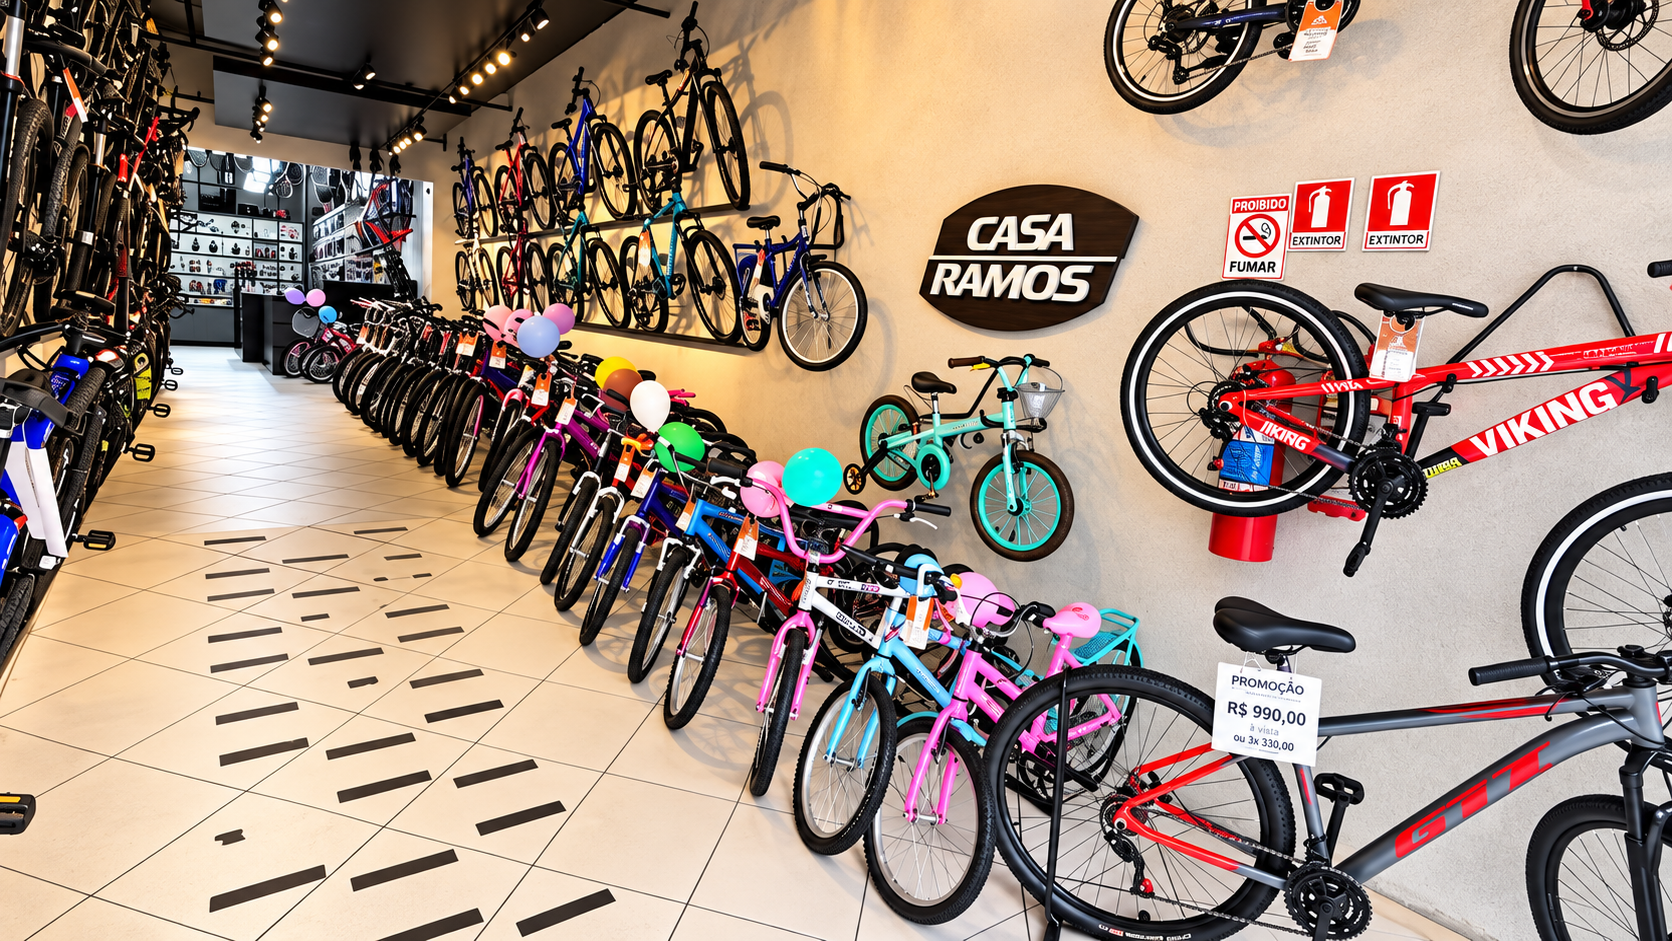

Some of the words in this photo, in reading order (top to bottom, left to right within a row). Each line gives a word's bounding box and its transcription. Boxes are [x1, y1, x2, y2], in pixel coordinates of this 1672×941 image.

[1233, 198, 1287, 212] PROIBIDO
[967, 213, 1073, 251] CASA
[1292, 235, 1342, 246] EXTINTOR
[1368, 234, 1425, 246] EXTINTOR
[1229, 261, 1277, 273] FUMAR
[929, 263, 1094, 303] RAMOS
[1469, 382, 1619, 457] VIKING
[1231, 675, 1304, 695] PROMOÇÃO
[1227, 701, 1247, 718] R$
[1253, 705, 1307, 726] 990,00
[1233, 734, 1245, 743] ou
[1248, 735, 1260, 746] 3x
